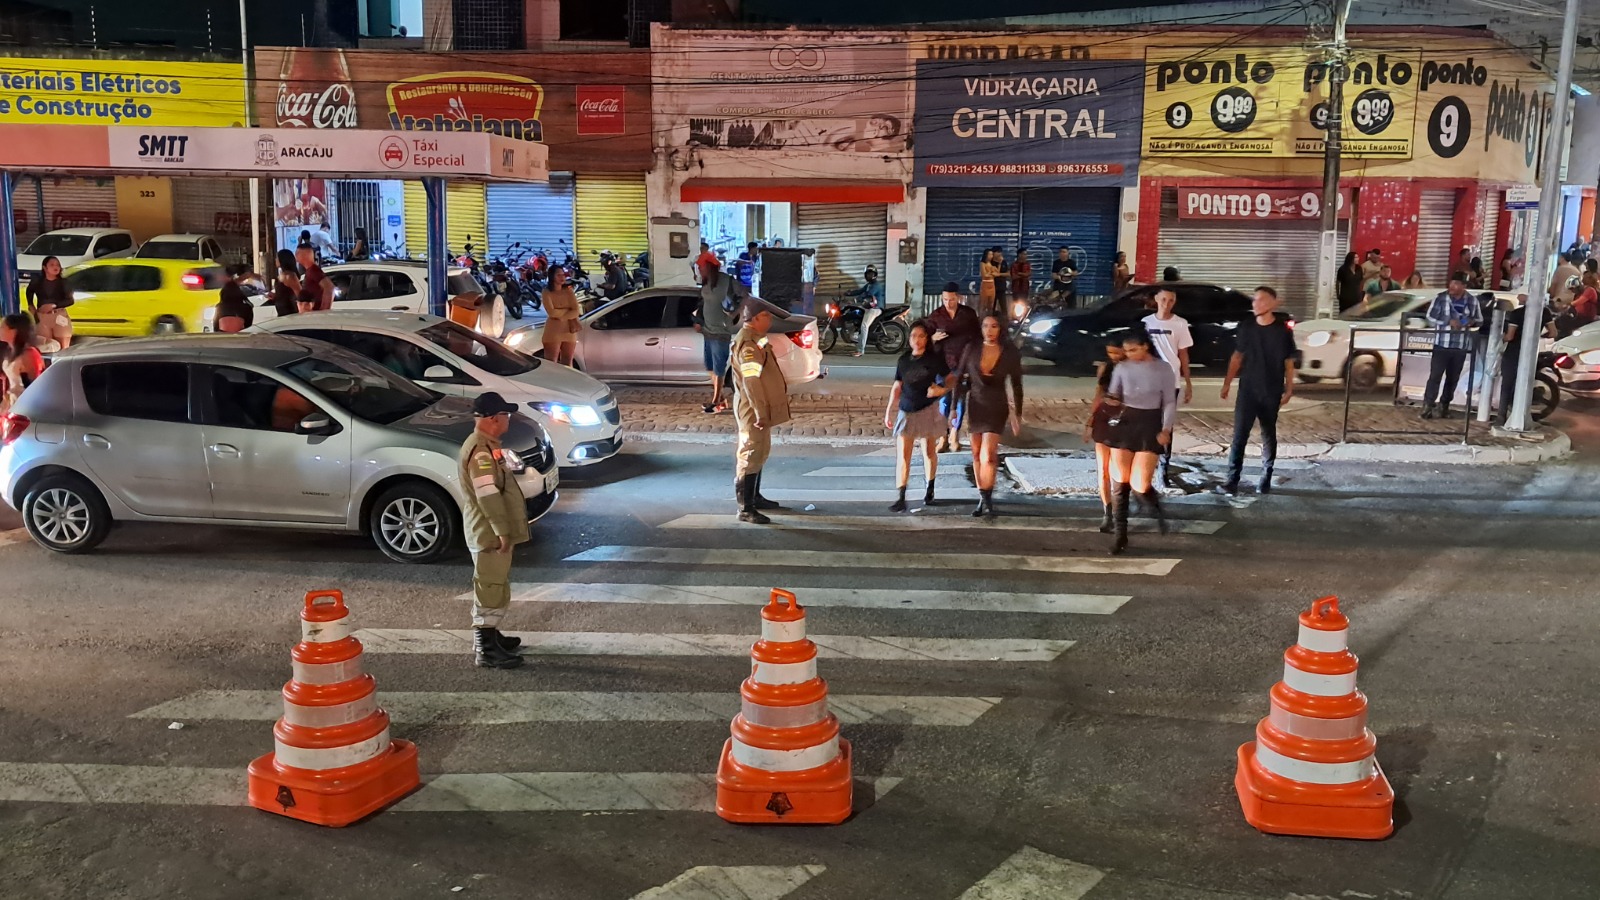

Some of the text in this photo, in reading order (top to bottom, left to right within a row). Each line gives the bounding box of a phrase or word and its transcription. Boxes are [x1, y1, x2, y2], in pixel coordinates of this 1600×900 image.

[81, 72, 182, 94] Elétricos
[1157, 54, 1275, 91] ponto
[1420, 58, 1487, 91] ponto
[398, 84, 458, 100] Restaurante
[469, 84, 533, 100] Delicatessen
[963, 76, 1100, 99] VIDRAÇARIA
[16, 95, 152, 123] Construção
[1172, 105, 1187, 126] 9
[1484, 78, 1526, 152] ponto
[951, 107, 1118, 139] CENTRAL
[1439, 104, 1459, 147] 9
[138, 134, 188, 156] SMTT
[281, 147, 334, 158] ARACAJU
[412, 138, 438, 152] Táxi
[1149, 141, 1166, 149] NÃO
[1175, 141, 1227, 150] PROPAGANDA
[1230, 142, 1273, 150] ENGANOSA!
[1369, 143, 1409, 151] ENGANOSA!
[413, 154, 465, 168] Especial
[140, 190, 155, 198] 323
[1187, 193, 1251, 216] PONTO
[1255, 193, 1272, 217] 9
[1301, 192, 1344, 217] 9,
